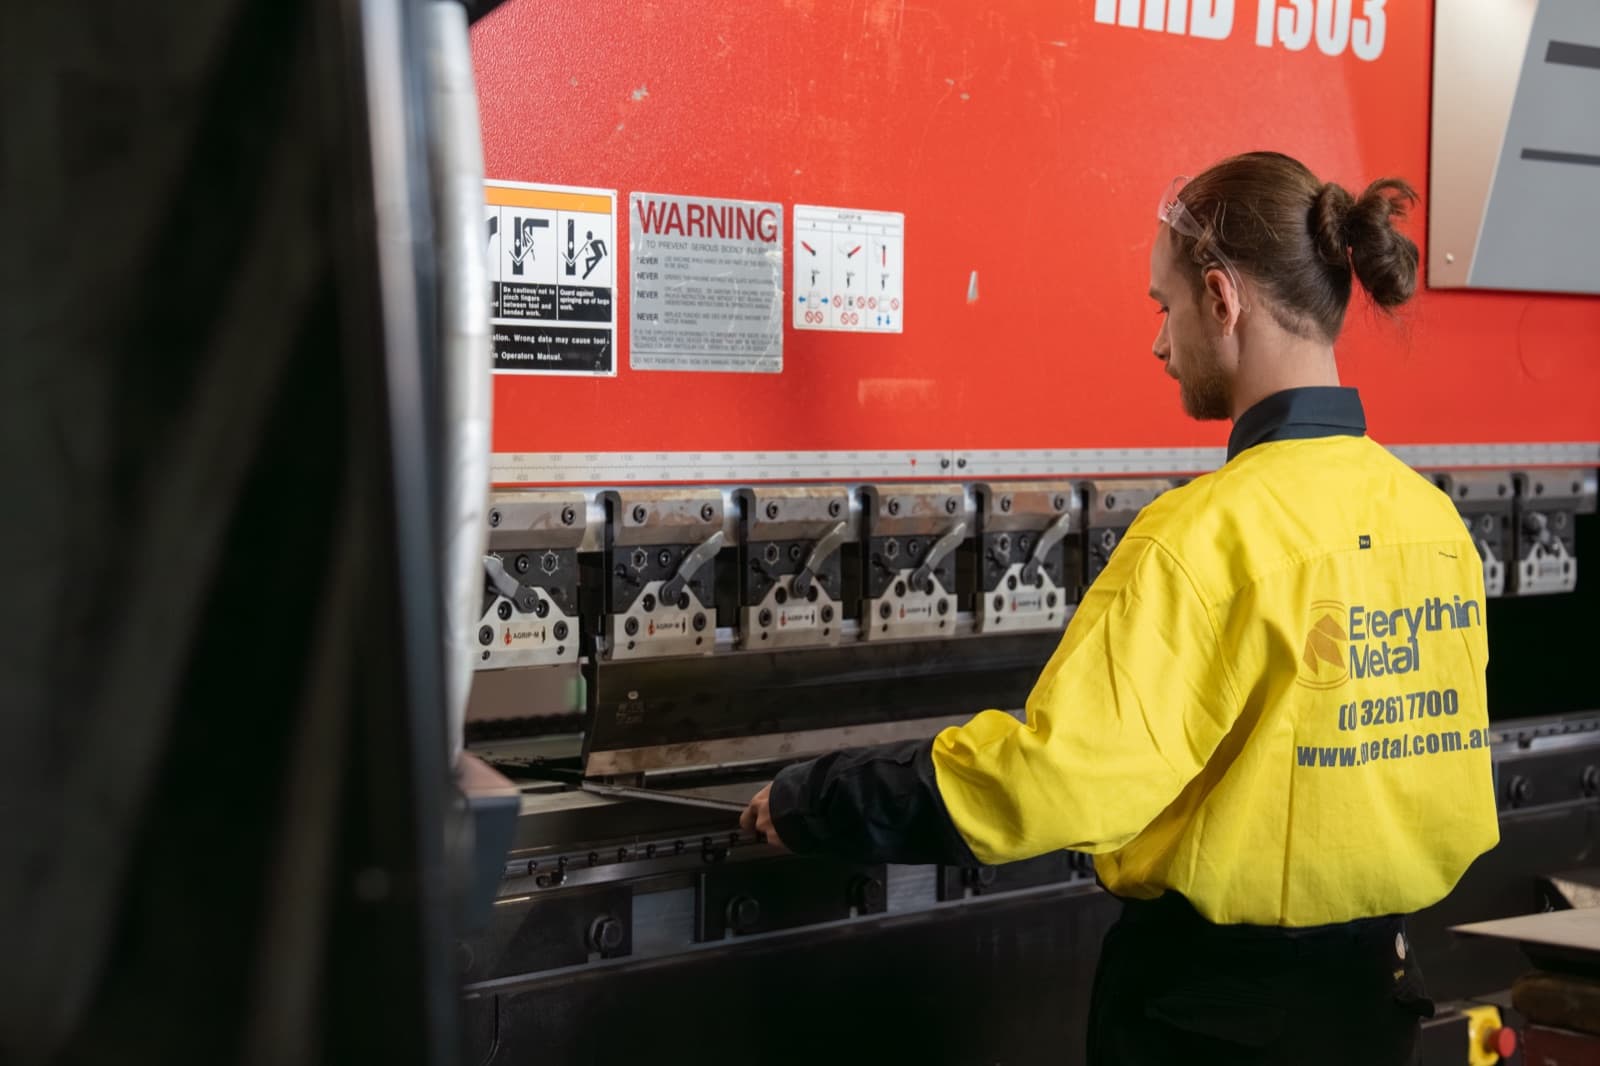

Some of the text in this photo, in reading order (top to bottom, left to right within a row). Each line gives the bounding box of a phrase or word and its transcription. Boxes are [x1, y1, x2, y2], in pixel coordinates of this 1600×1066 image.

[637, 199, 778, 243] WARNING
[645, 240, 656, 249] TO
[658, 241, 688, 251] PREVENT
[691, 243, 719, 253] SERIOUS
[636, 272, 659, 281] NEVER
[560, 288, 575, 296] Guard
[636, 290, 659, 299] NEVER
[520, 294, 540, 302] fingers
[597, 297, 610, 306] large
[503, 301, 527, 309] between
[503, 308, 541, 317] bended work.
[636, 312, 659, 321] NEVER
[513, 334, 535, 344] Wrong
[537, 335, 553, 344] data
[555, 336, 569, 345] may
[571, 337, 590, 345] cause
[501, 351, 534, 361] Operators
[537, 352, 563, 361] Manual.
[1350, 595, 1481, 643] Eerythin
[513, 631, 540, 639] AGRIP-M
[1350, 636, 1420, 680] Metal
[1406, 688, 1459, 721] 7700
